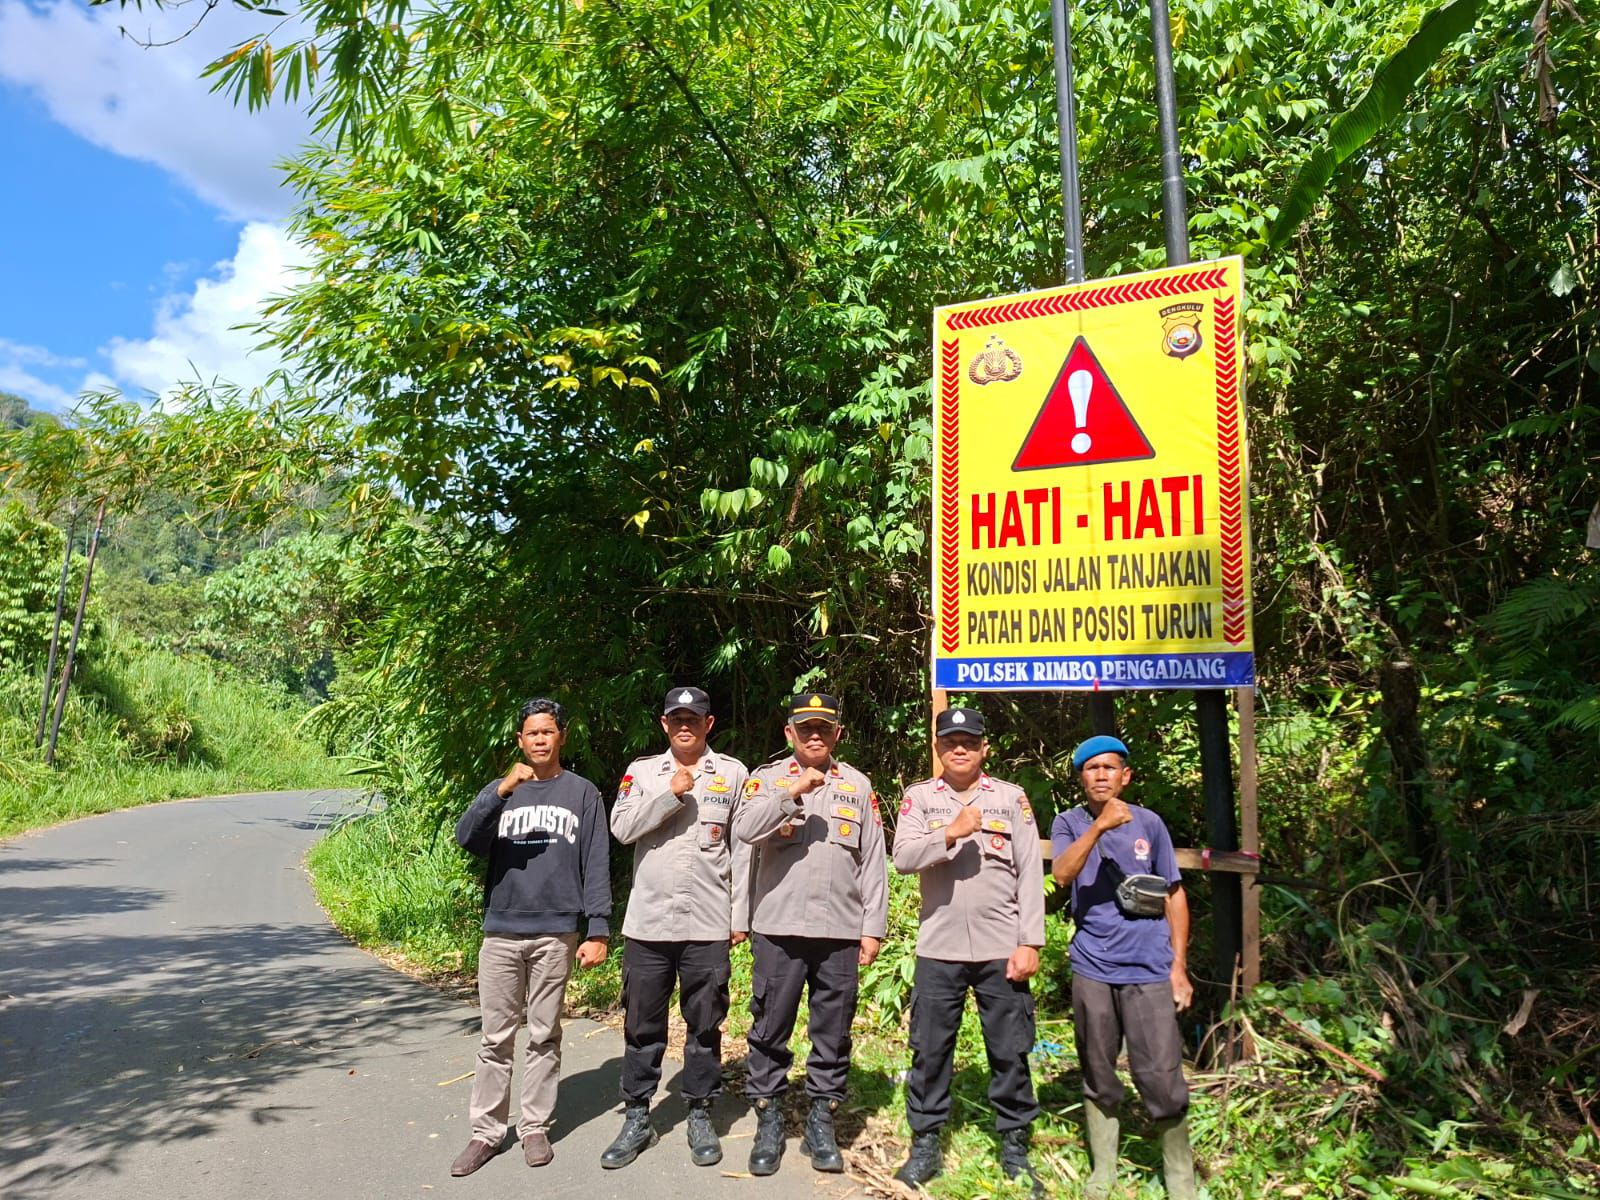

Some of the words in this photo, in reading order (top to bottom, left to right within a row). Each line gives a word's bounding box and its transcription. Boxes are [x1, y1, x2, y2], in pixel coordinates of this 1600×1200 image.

[1161, 304, 1201, 316] BENGKULU
[971, 487, 1061, 550] HATI
[1103, 474, 1204, 541] HATI
[967, 559, 1037, 597] KONDISI
[1043, 555, 1102, 592] JALAN
[1107, 549, 1211, 590] TANJAKAN
[967, 609, 1022, 645] PATAH
[1029, 607, 1066, 643] DAN
[1072, 604, 1135, 643] POSISI
[1141, 601, 1213, 641] TURUN
[957, 661, 1029, 682] POLSEK
[1033, 661, 1096, 681] RIMBO
[1101, 658, 1226, 680] PENGADANG
[703, 796, 730, 805] POLRI
[833, 793, 860, 806] POLRI
[983, 808, 1010, 817] POLRI
